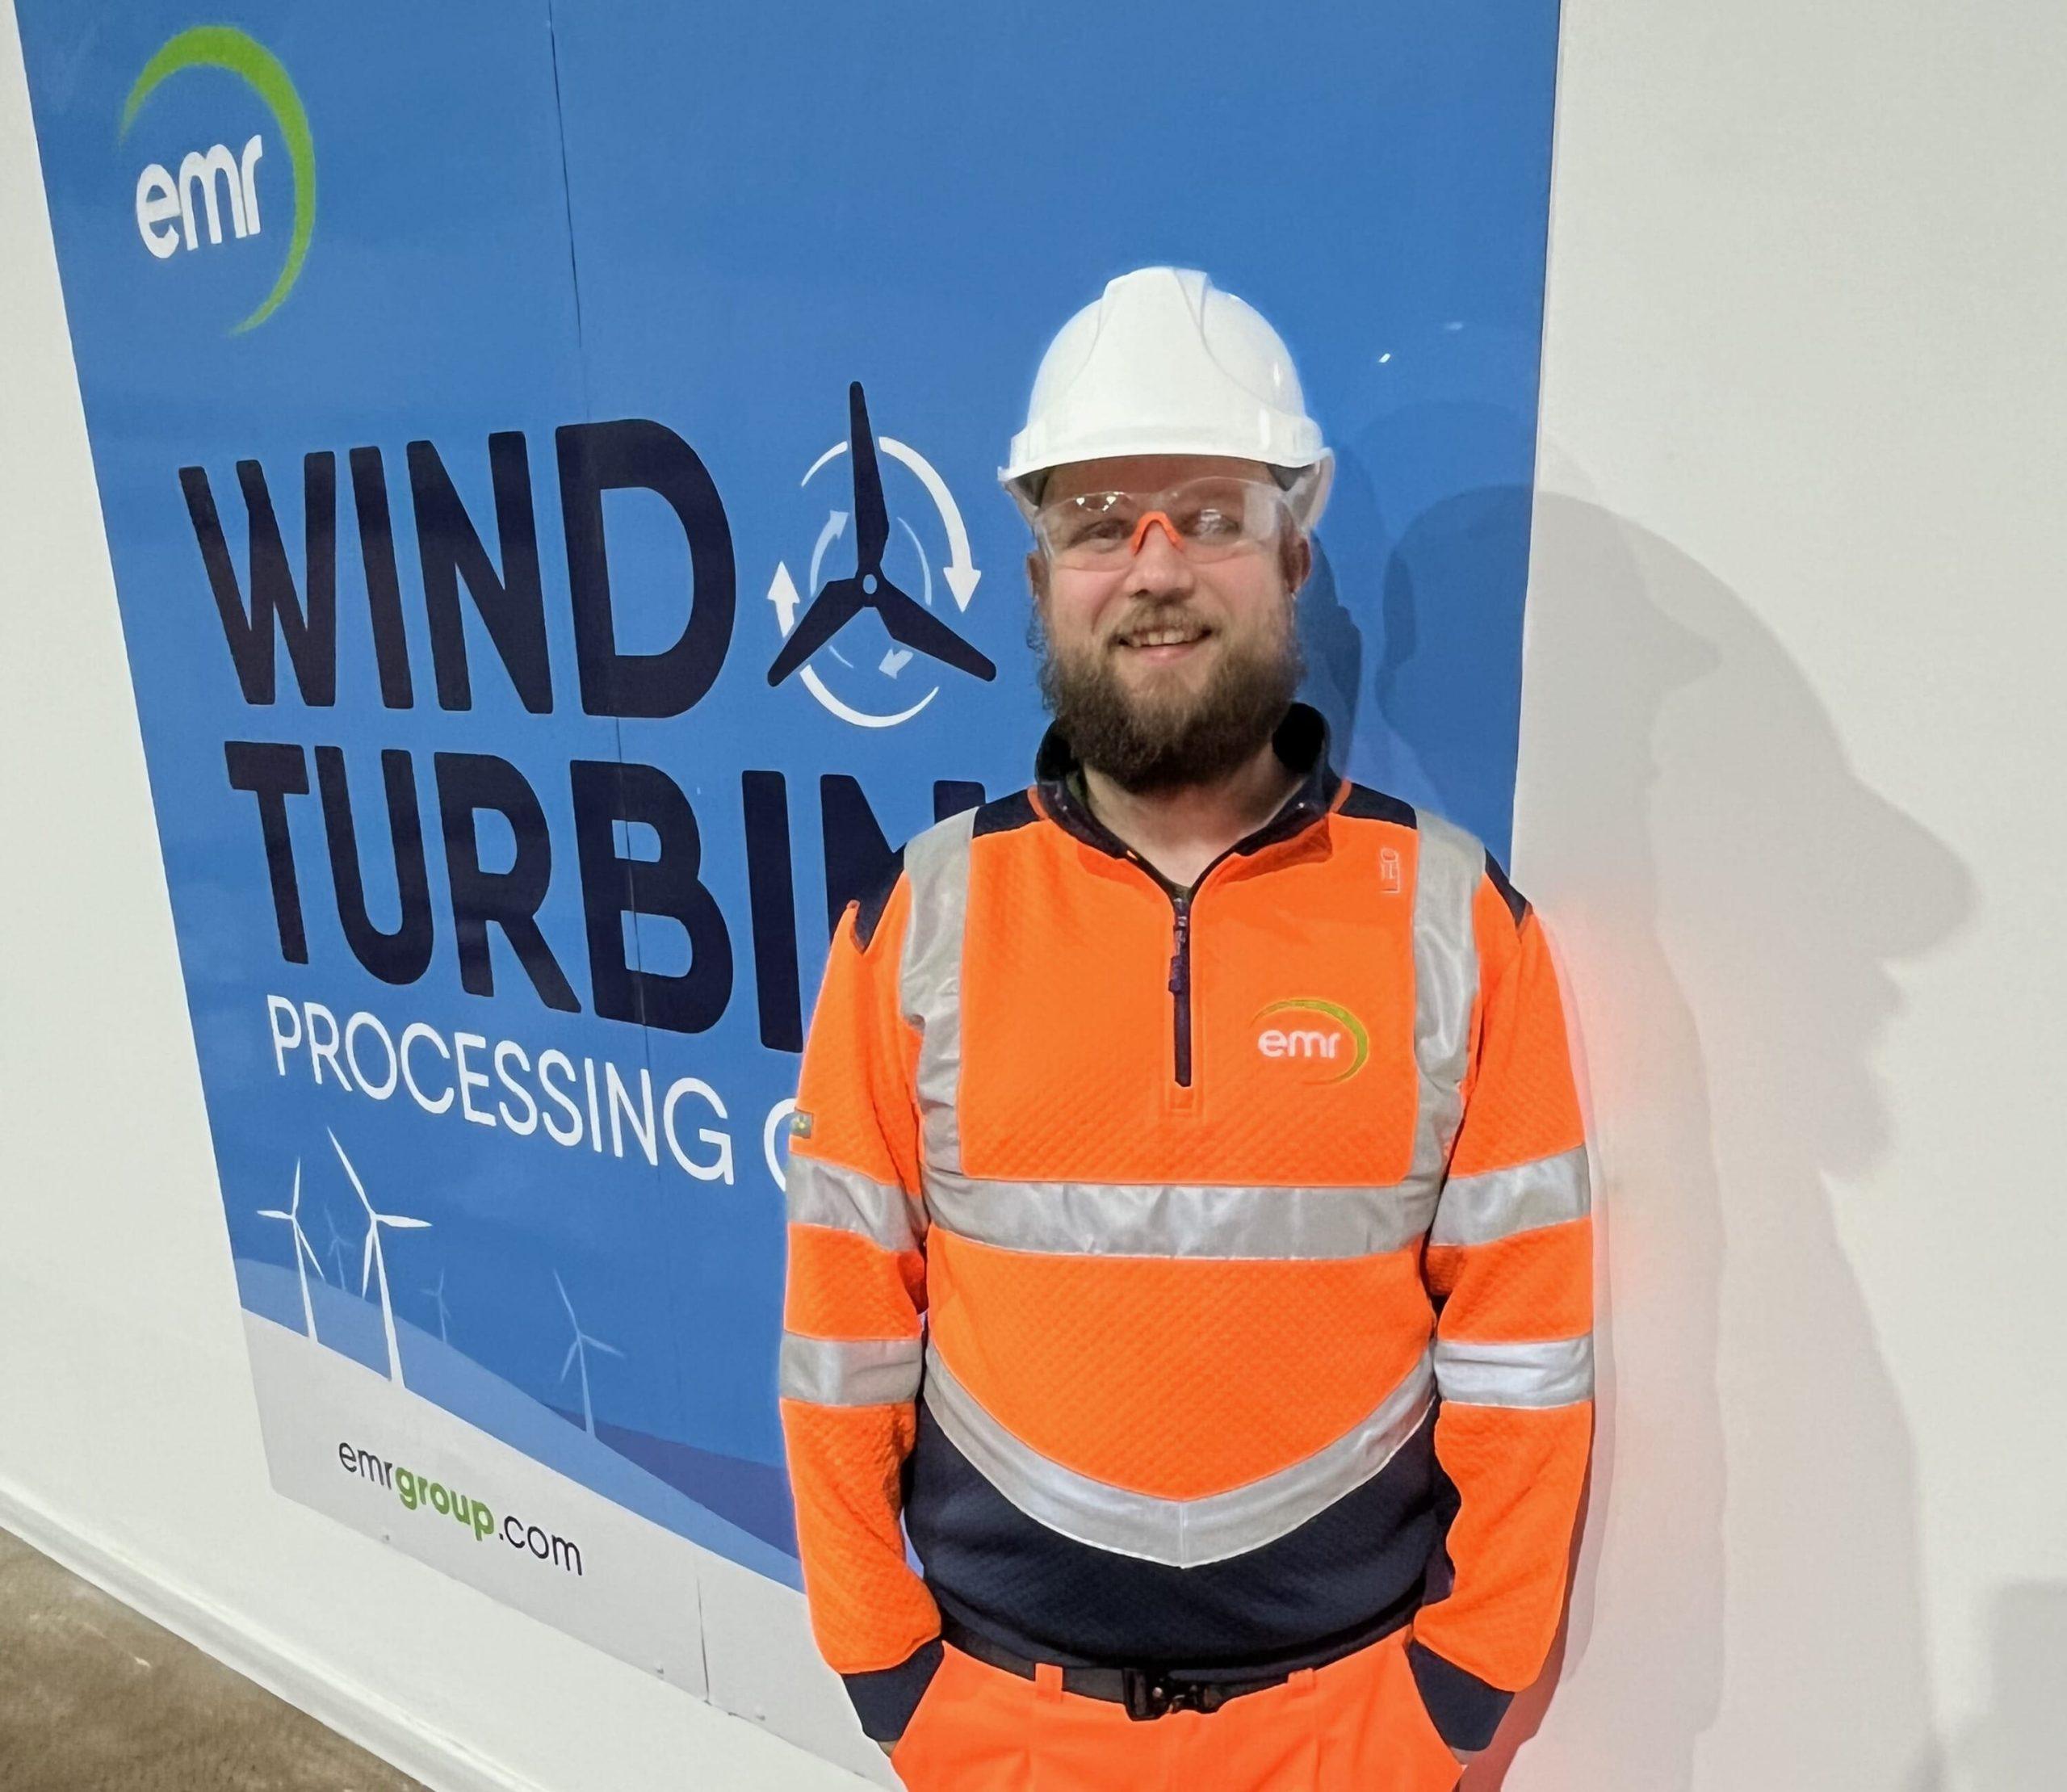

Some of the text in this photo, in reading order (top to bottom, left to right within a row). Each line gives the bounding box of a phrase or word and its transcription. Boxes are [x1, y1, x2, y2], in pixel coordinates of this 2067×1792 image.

[135, 134, 263, 259] emr
[178, 418, 737, 719] WIND
[266, 994, 735, 1186] PROCESSING
[1257, 1029, 1341, 1060] emr
[338, 1441, 584, 1577] emrgroup.com
